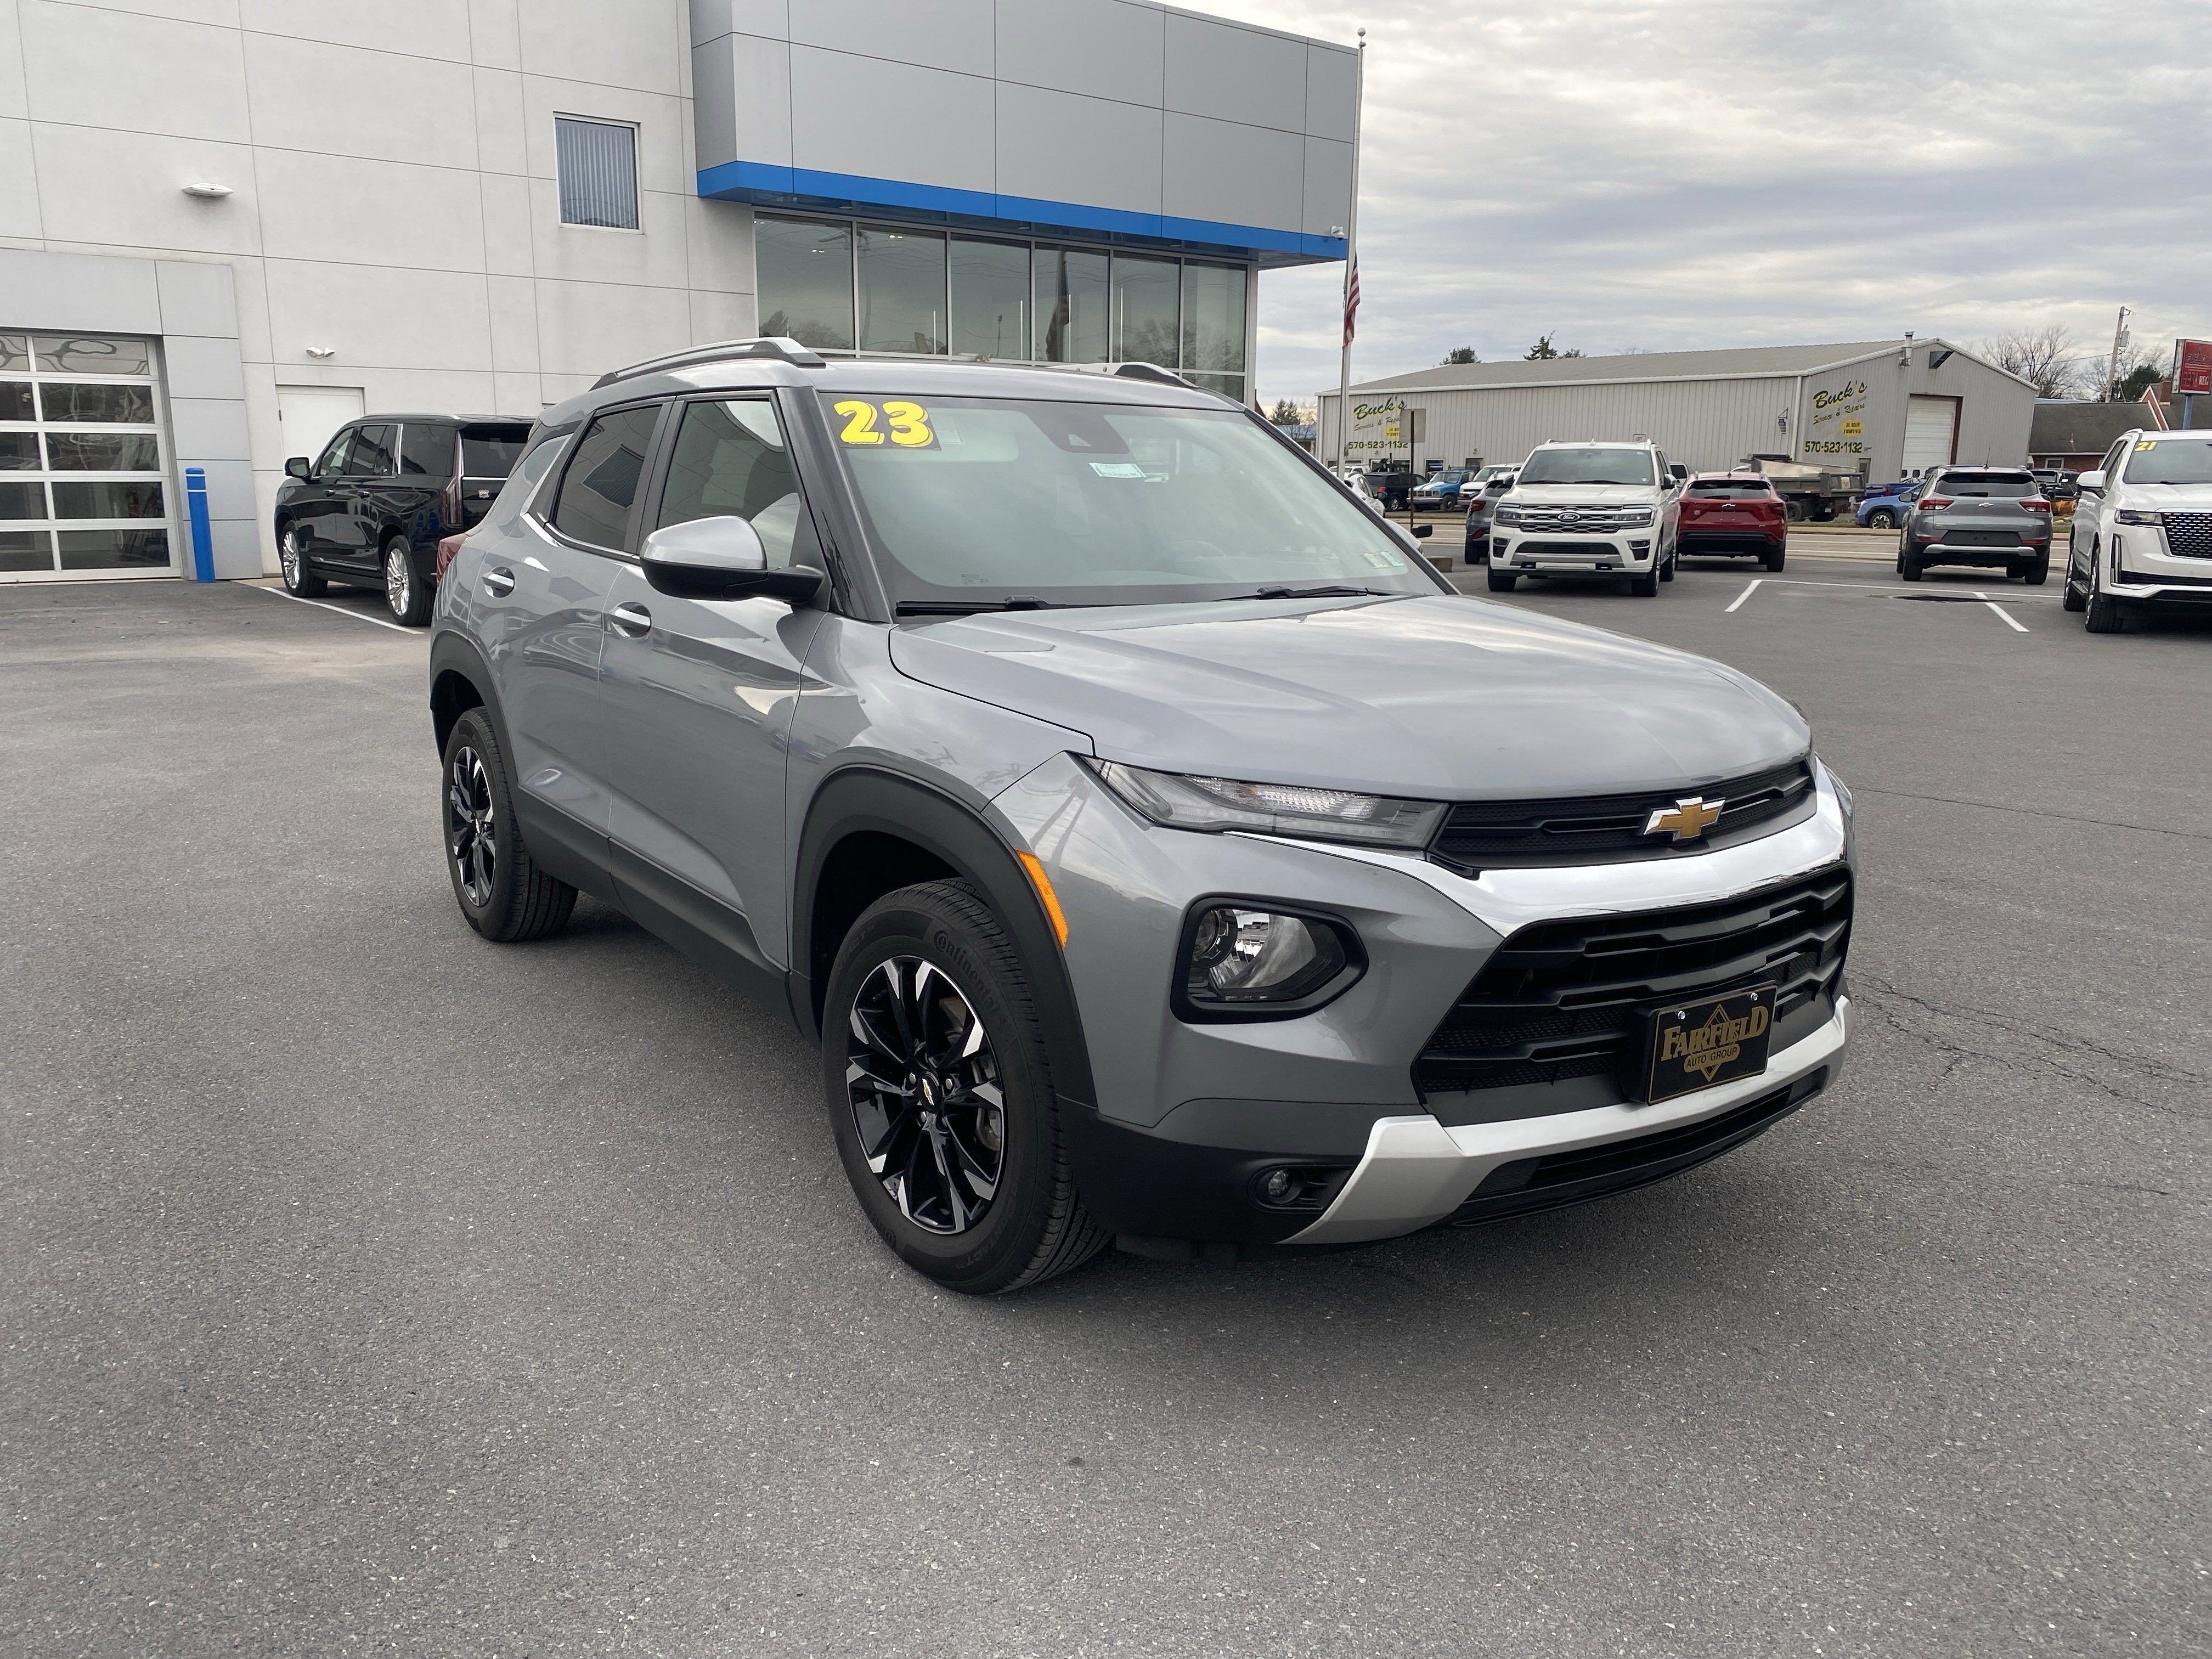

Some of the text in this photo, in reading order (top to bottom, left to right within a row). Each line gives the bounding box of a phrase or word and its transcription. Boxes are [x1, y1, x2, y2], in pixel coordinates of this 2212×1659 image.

[2199, 375, 2209, 385] REG
[1813, 380, 1867, 409] Buck's
[1353, 396, 1408, 420] Buck's
[833, 400, 934, 448] 23
[1348, 441, 1408, 449] 570-523-1132
[1804, 441, 1863, 453] 570-523-1132
[2134, 441, 2158, 452] 21
[933, 929, 1002, 1016] Continental
[1661, 1005, 1769, 1062] FAIRFIELD
[1686, 1047, 1738, 1068] AUTO GROUP
